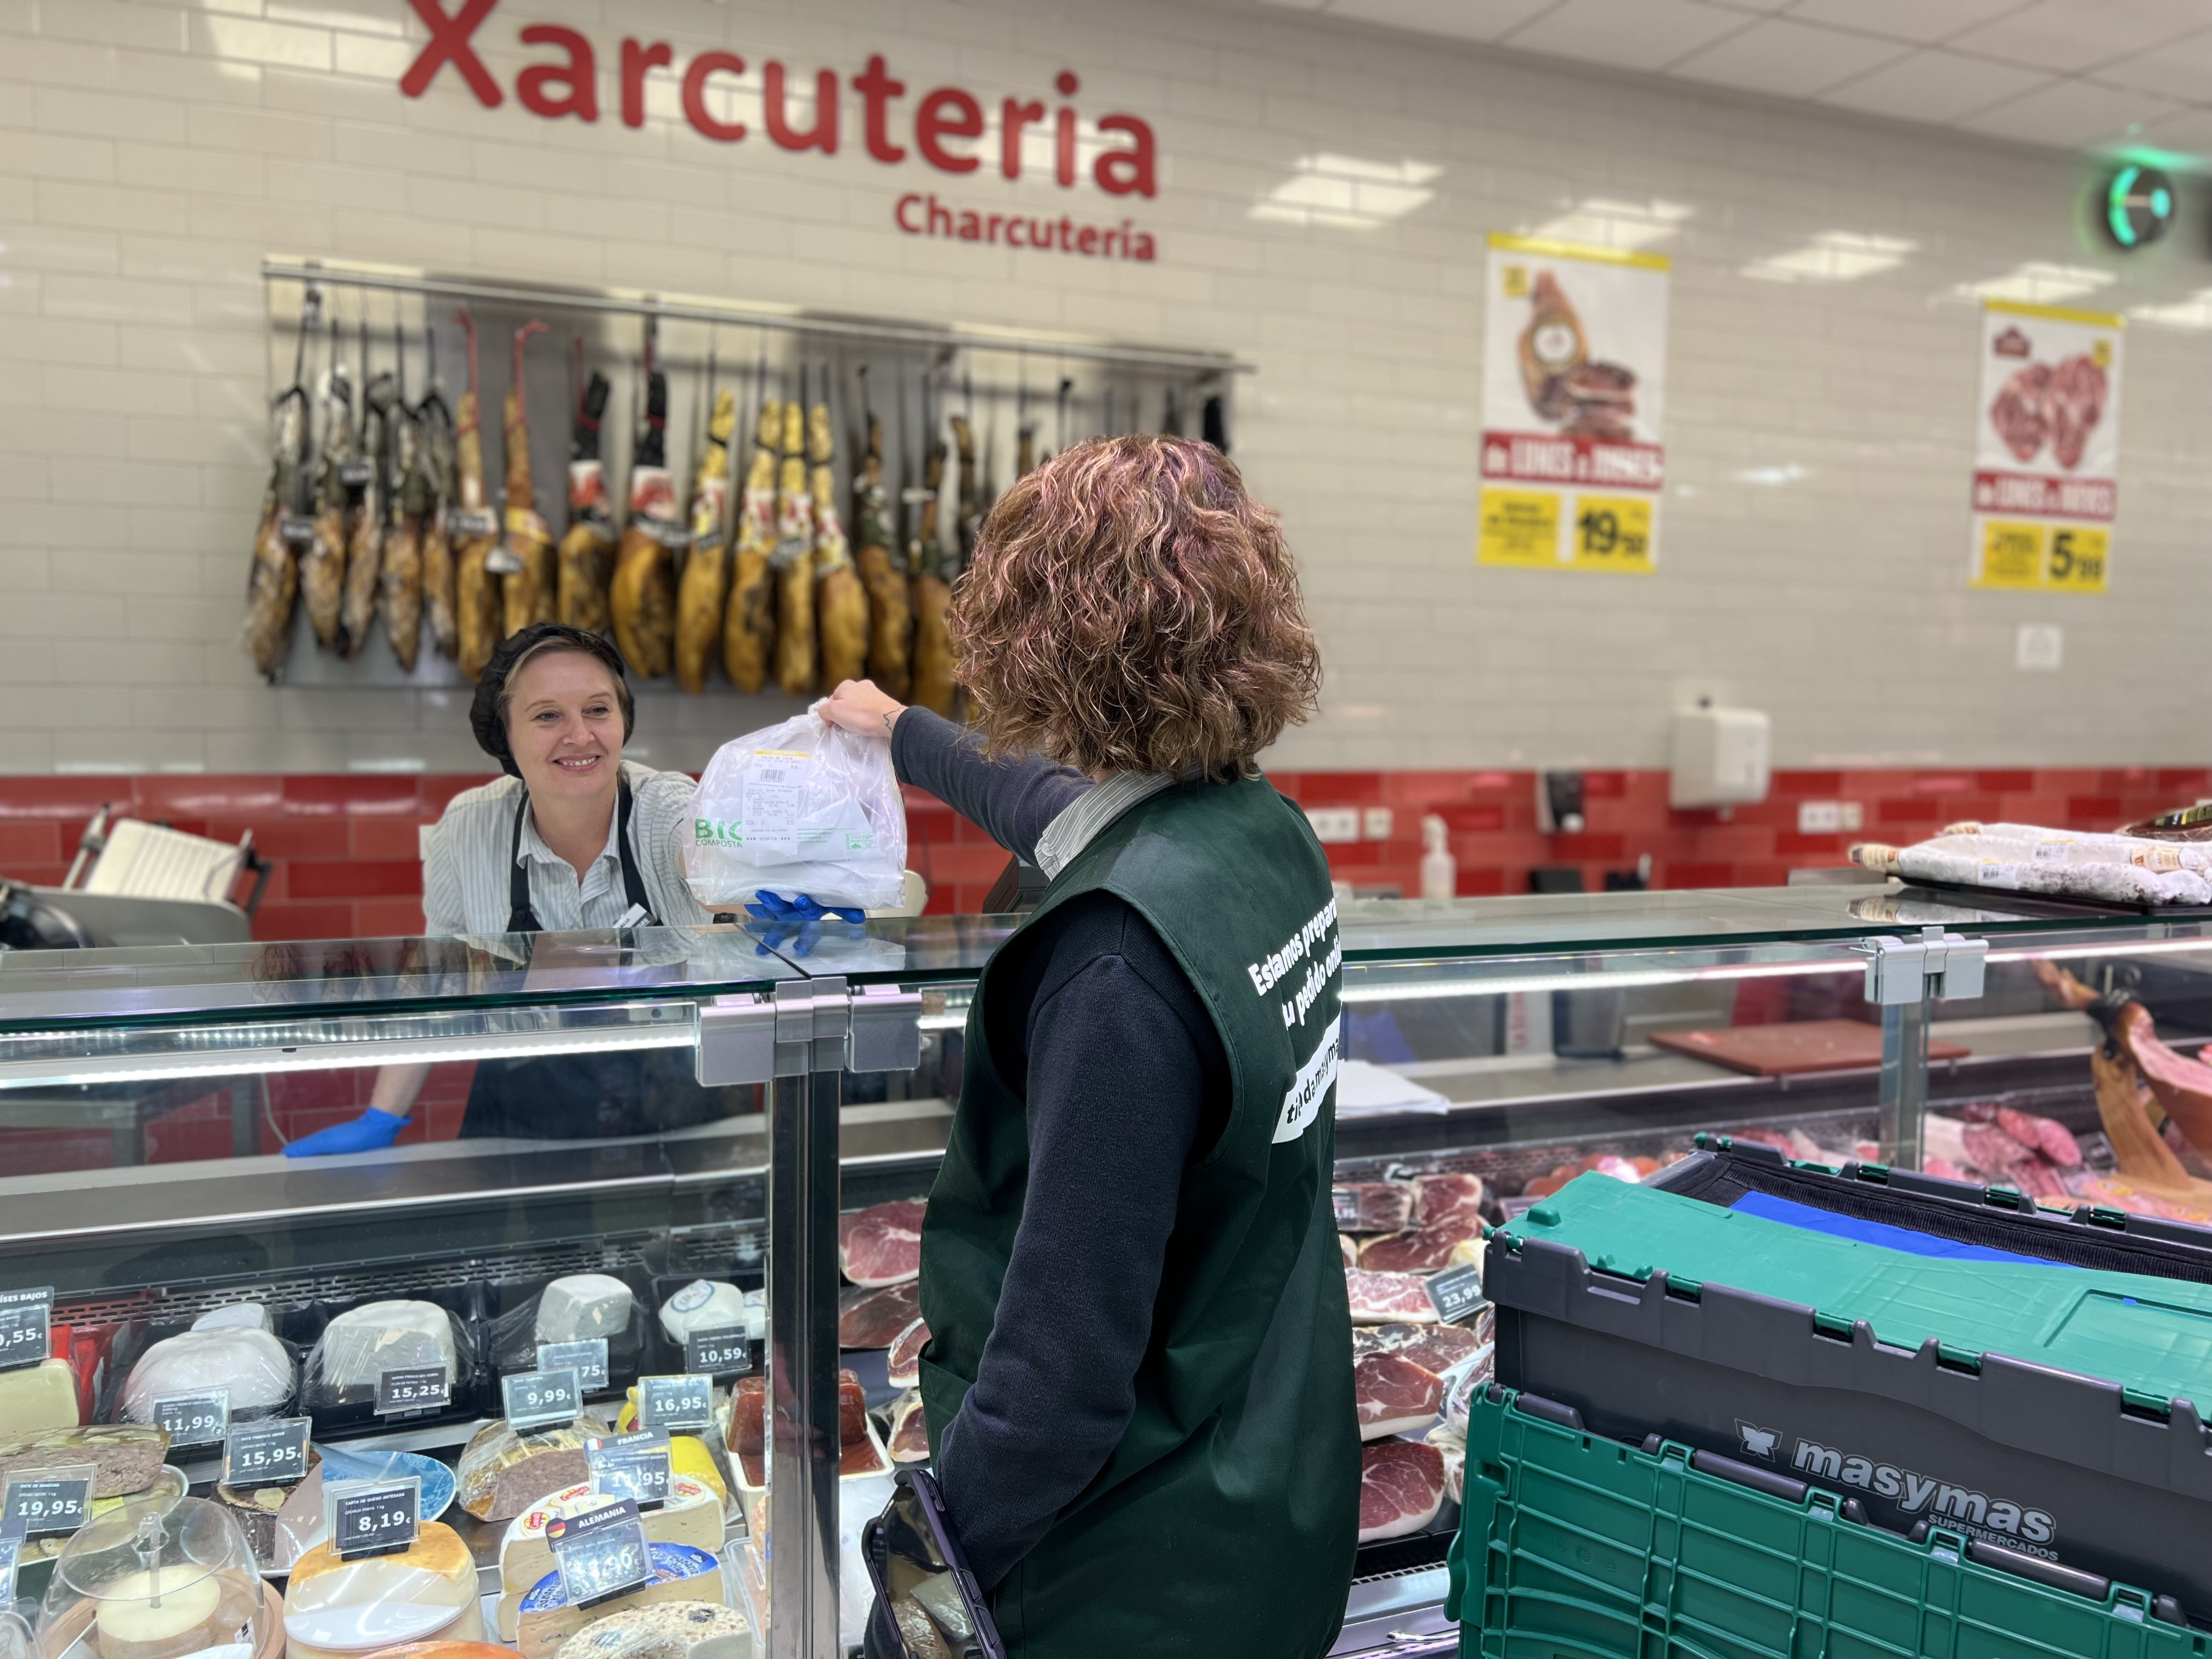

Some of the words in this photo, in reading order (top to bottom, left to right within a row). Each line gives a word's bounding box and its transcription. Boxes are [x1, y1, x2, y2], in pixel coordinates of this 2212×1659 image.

[398, 0, 1158, 199] Xarcuteria
[895, 193, 1156, 262] Charcutería
[1248, 933, 1304, 996] Estamos
[1296, 961, 1325, 1026] pedido
[20, 1291, 48, 1301] BAJOS
[655, 1397, 707, 1412] 16,95€
[617, 1431, 654, 1446] FRANCIA
[242, 1446, 302, 1467] 15,95€
[1792, 1439, 2056, 1544] masymas
[18, 1500, 83, 1517] 19,95€
[579, 1506, 627, 1529] ALEMANIA
[359, 1510, 411, 1532] 8,19€
[1928, 1514, 2059, 1561] SUPERMERCADOS
